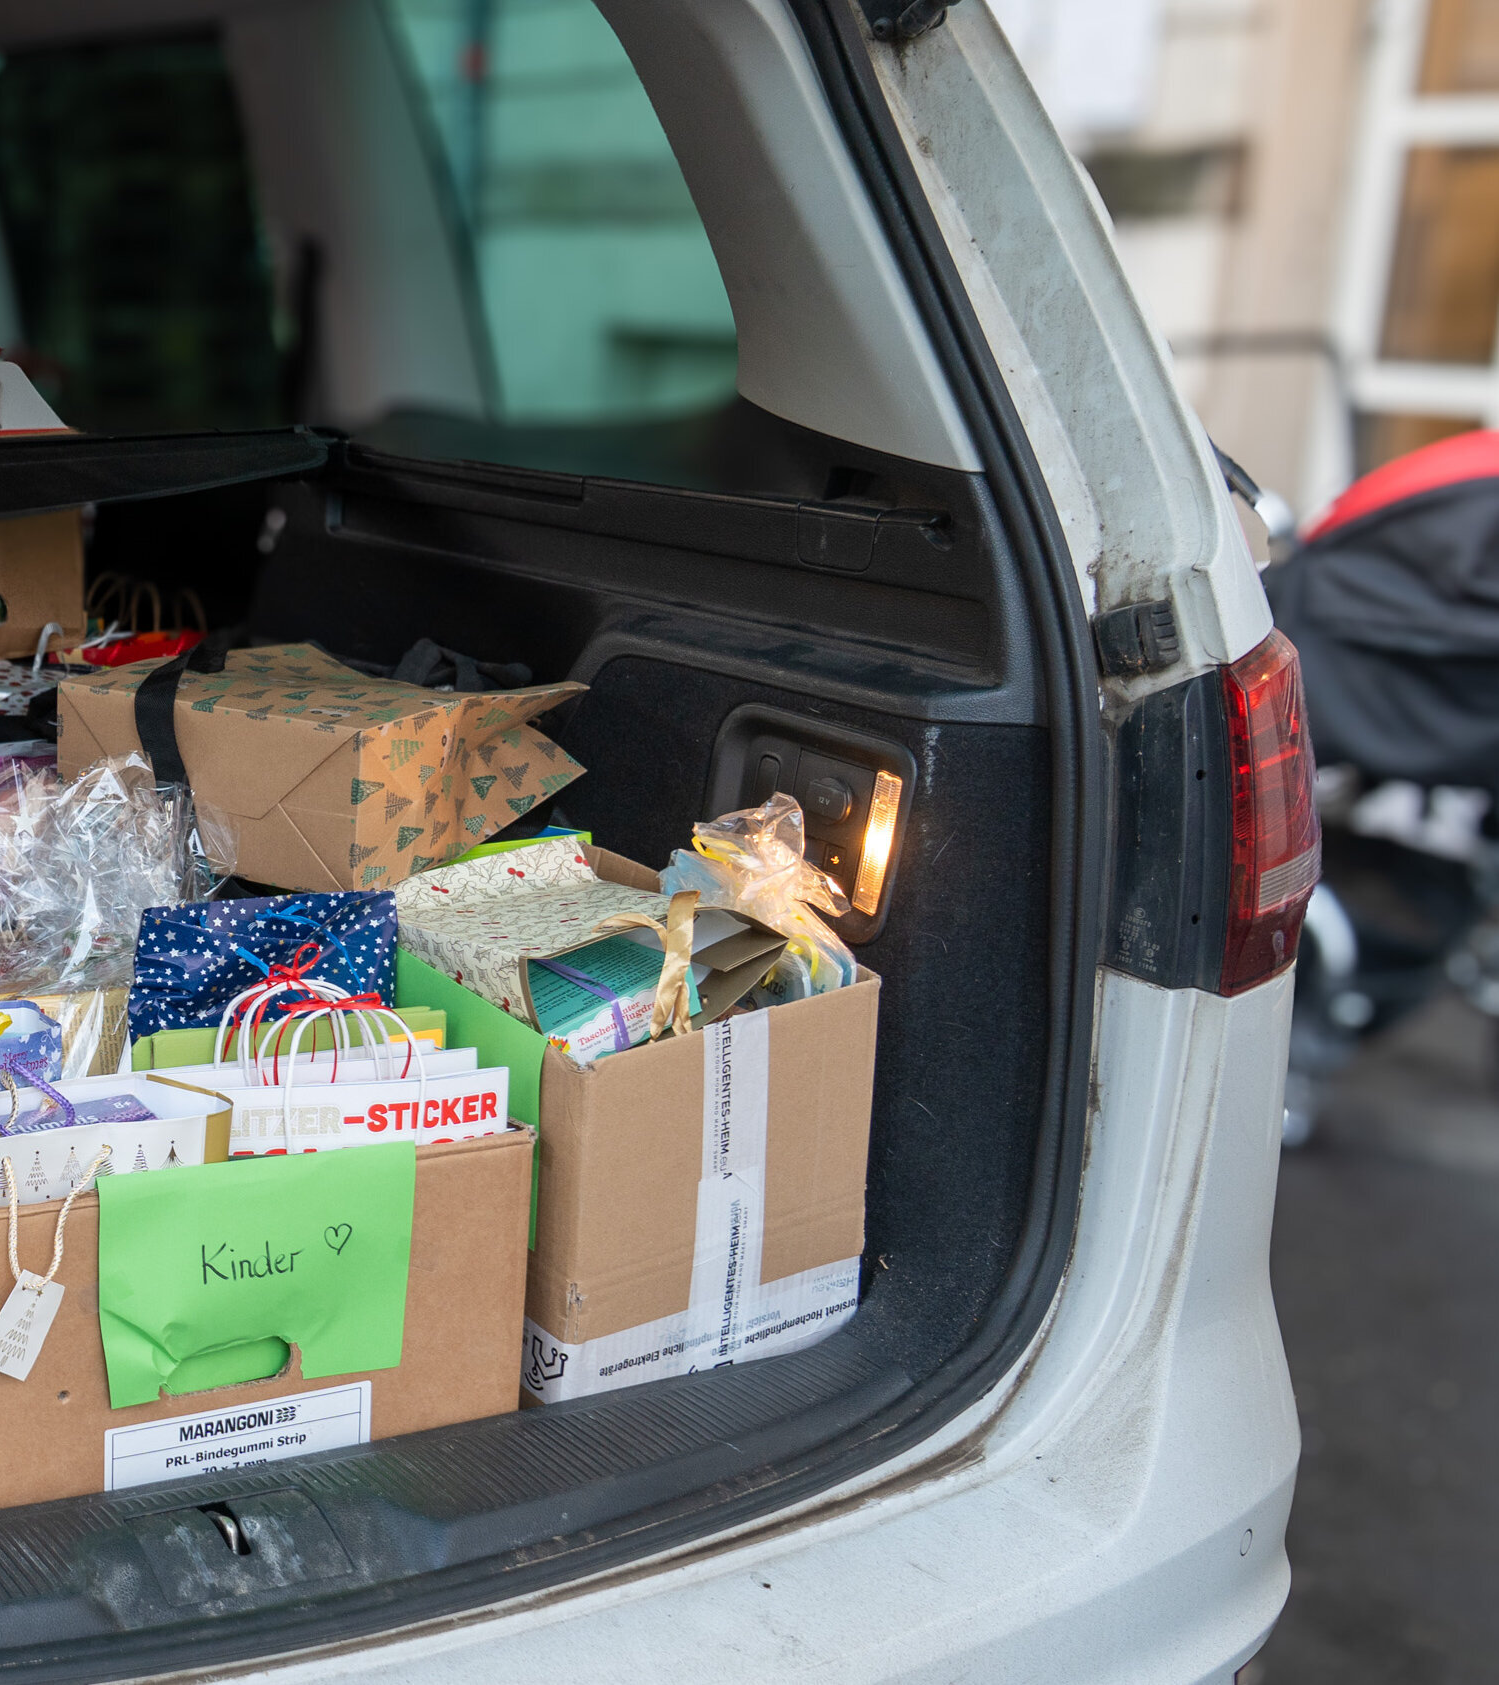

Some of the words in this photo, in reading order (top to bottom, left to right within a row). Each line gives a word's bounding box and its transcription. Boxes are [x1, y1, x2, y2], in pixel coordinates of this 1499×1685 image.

[113, 1099, 132, 1109] 8+
[719, 1018, 732, 1171] NTELLIGENTES-HEIM.eu
[202, 1240, 304, 1285] Kinder
[825, 1298, 857, 1317] orsicht
[744, 1308, 823, 1344] Hochempfindliche
[599, 1350, 660, 1377] Elektrogeräte
[179, 1410, 274, 1442] MARANGONI
[165, 1437, 274, 1468] PRL-Bindegummi
[276, 1432, 307, 1447] Strip
